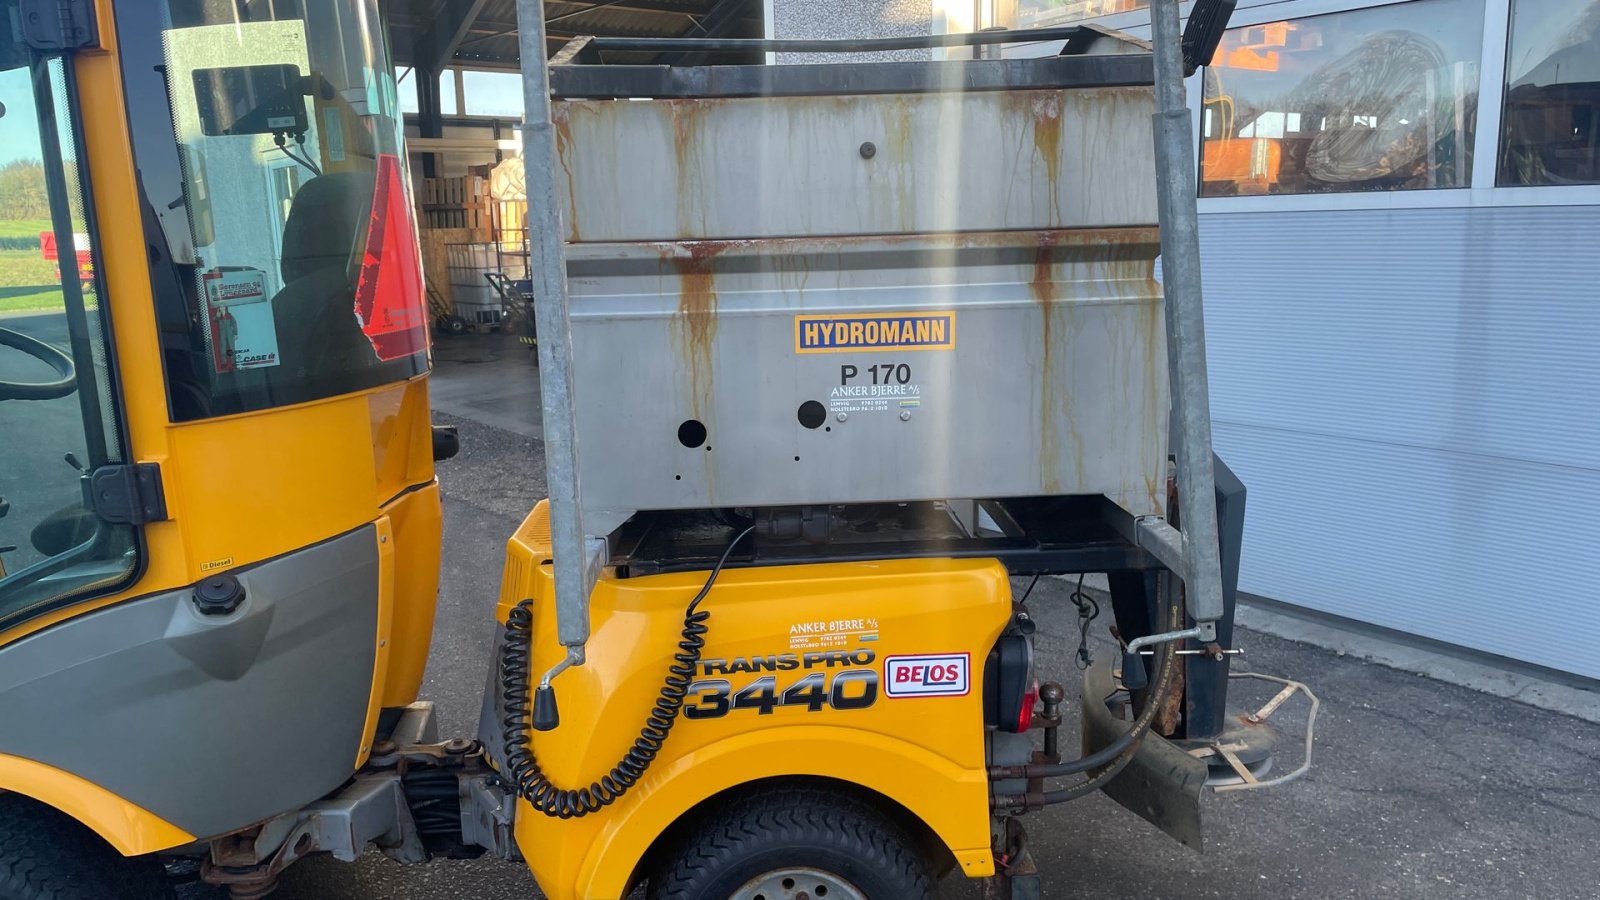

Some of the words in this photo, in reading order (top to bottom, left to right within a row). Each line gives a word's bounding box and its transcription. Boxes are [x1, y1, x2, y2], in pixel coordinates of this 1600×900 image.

[804, 319, 945, 346] HYDROMANN
[243, 354, 267, 363] CASE
[841, 364, 858, 386] P
[867, 363, 911, 385] 170
[830, 386, 868, 397] ANKER
[871, 385, 906, 396] BJERRE
[908, 384, 920, 395] A/S
[209, 558, 231, 569] Diesel
[789, 622, 827, 634] ANKER
[829, 619, 864, 632] BJERRE
[866, 617, 879, 629] A/S
[802, 647, 876, 669] PRO
[895, 663, 959, 686] BELOS
[682, 669, 879, 720] 3440
